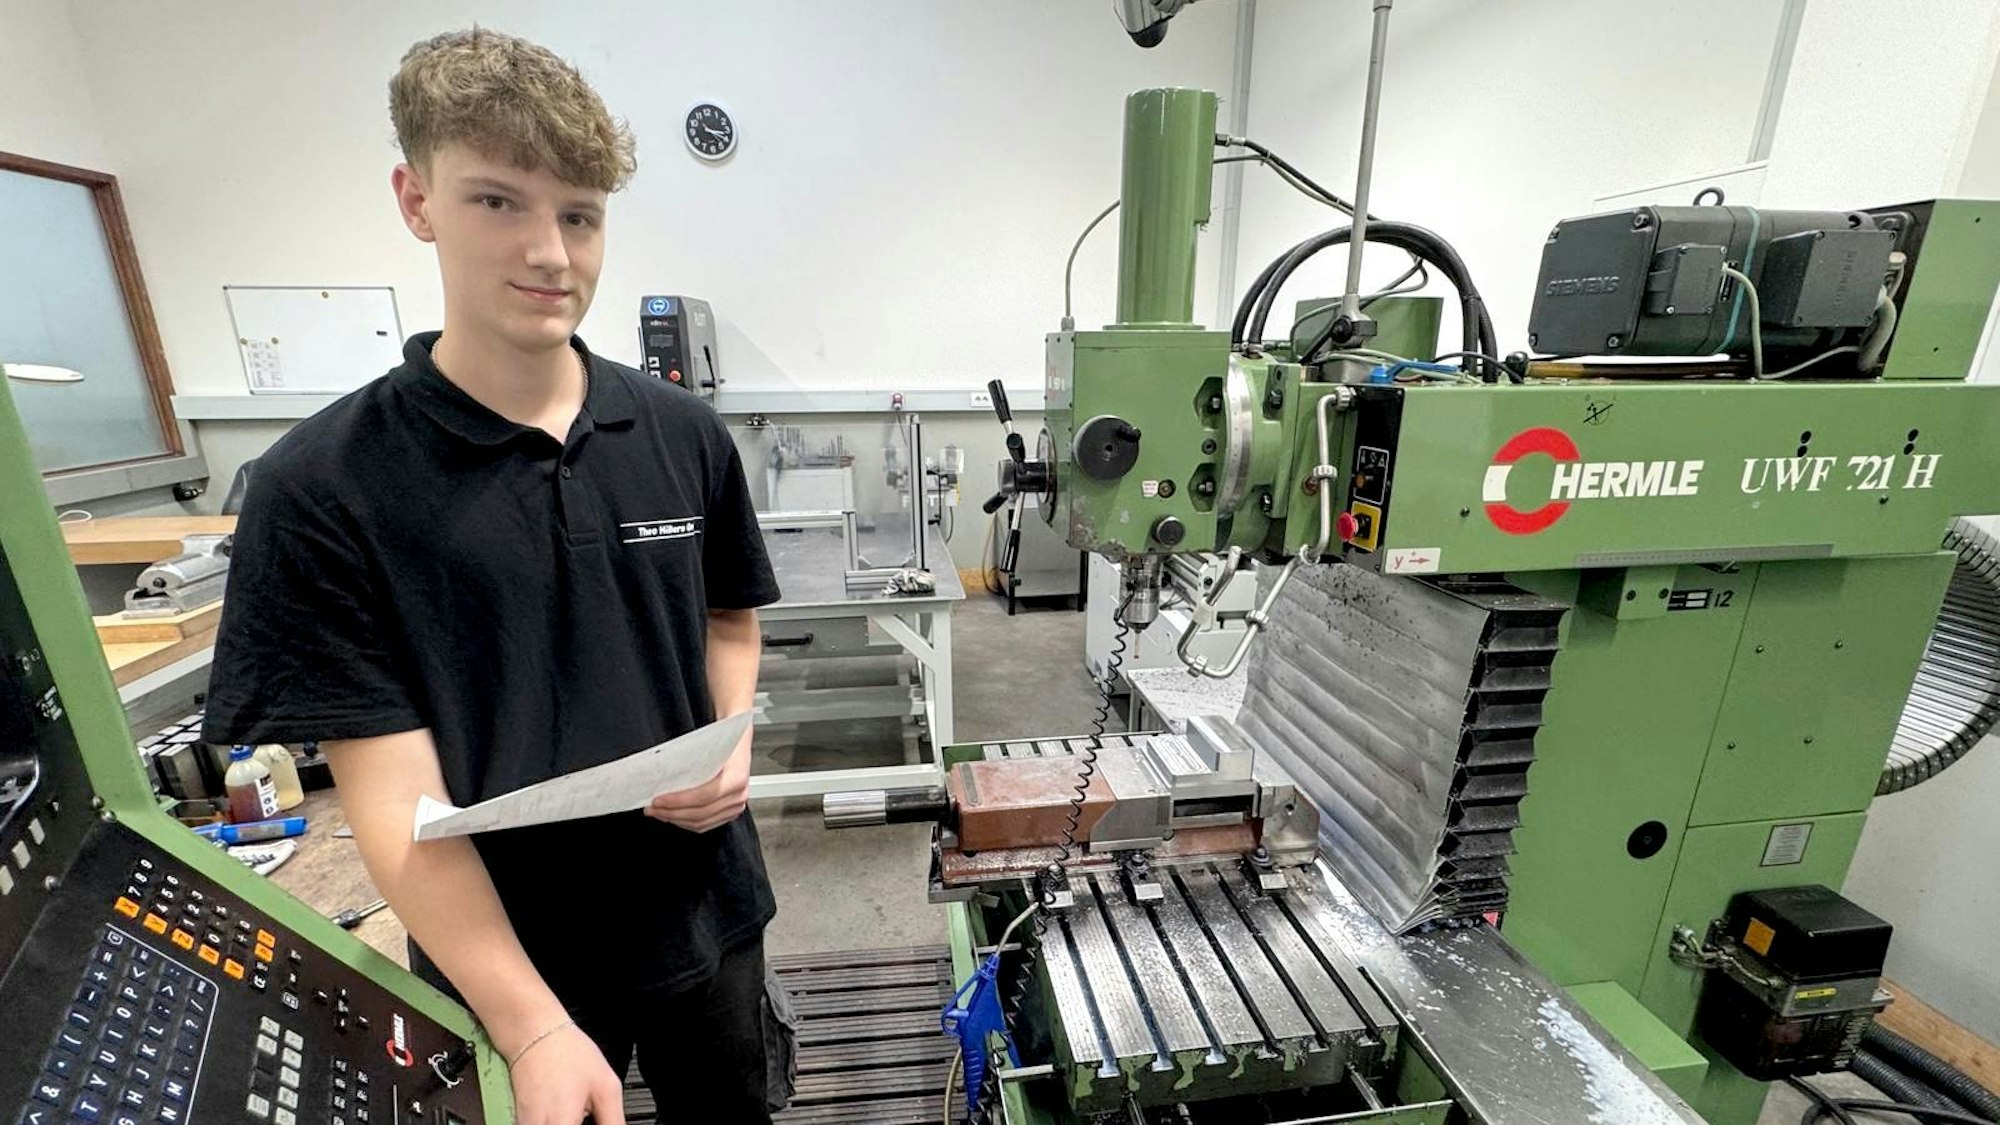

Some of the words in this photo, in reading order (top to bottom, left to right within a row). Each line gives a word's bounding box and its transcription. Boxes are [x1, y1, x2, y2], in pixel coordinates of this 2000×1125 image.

[695, 112, 703, 120] 11
[703, 108, 711, 117] 12
[690, 120, 699, 128] 10
[720, 117, 727, 126] 2
[1547, 275, 1620, 296] SIEMENS
[1550, 459, 1705, 500] HERMLE
[1740, 456, 1838, 494] UWF
[1846, 454, 1896, 491] 721
[1902, 454, 1944, 489] H
[1714, 590, 1735, 608] 12
[140, 859, 153, 869] 9
[134, 872, 148, 884] 8
[166, 876, 179, 885] 6
[128, 886, 141, 897] 7
[161, 888, 174, 898] 5
[191, 890, 204, 900] 3
[156, 902, 168, 913] 4
[187, 904, 200, 915] 2
[183, 918, 195, 927] 1
[185, 1018, 198, 1028] ?
[149, 1026, 164, 1036] L
[80, 1101, 98, 1112] T
[90, 1074, 107, 1086] Y
[100, 1050, 116, 1064] U
[108, 1030, 124, 1039] I
[124, 986, 138, 999] P
[142, 1044, 157, 1056] K
[136, 1067, 150, 1080] J
[41, 1086, 60, 1098] &
[167, 1082, 183, 1096] M
[127, 1090, 144, 1105] H
[161, 1106, 177, 1120] N
